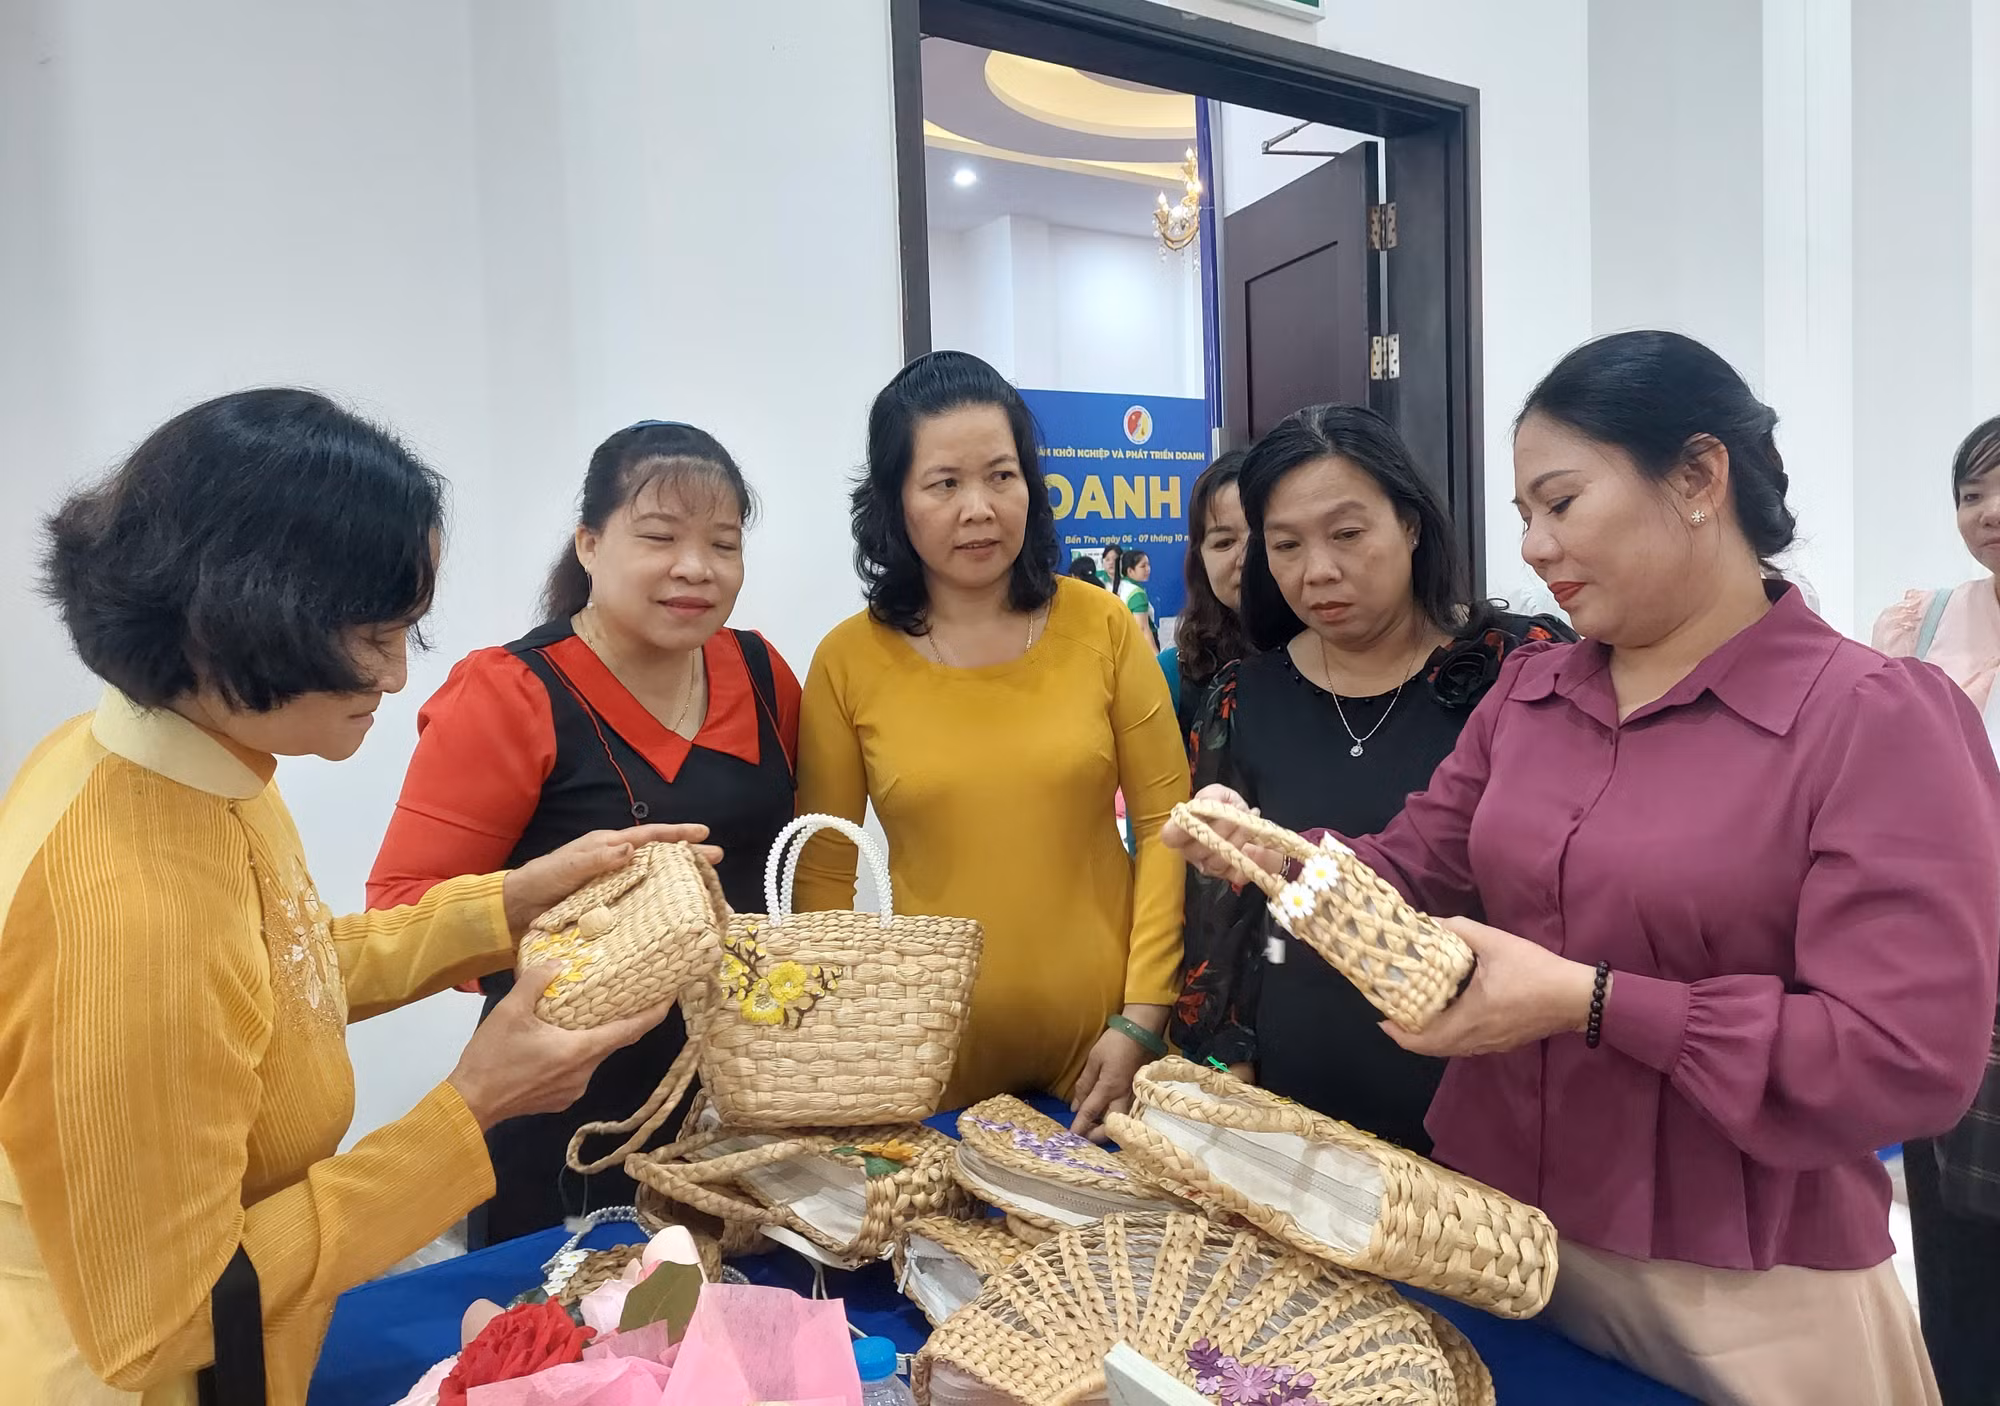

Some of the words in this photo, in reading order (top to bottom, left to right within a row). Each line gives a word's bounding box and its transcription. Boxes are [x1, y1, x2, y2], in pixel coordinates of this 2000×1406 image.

[1077, 447, 1110, 460] NGHIỆP
[1111, 447, 1124, 459] VÀ
[1125, 448, 1148, 459] PHÁT
[1175, 451, 1205, 461] DOANH
[1100, 534, 1120, 545] ngày
[1122, 534, 1132, 543] 06
[1138, 533, 1149, 543] 07
[1150, 532, 1173, 544] tháng
[1175, 533, 1183, 542] 10
